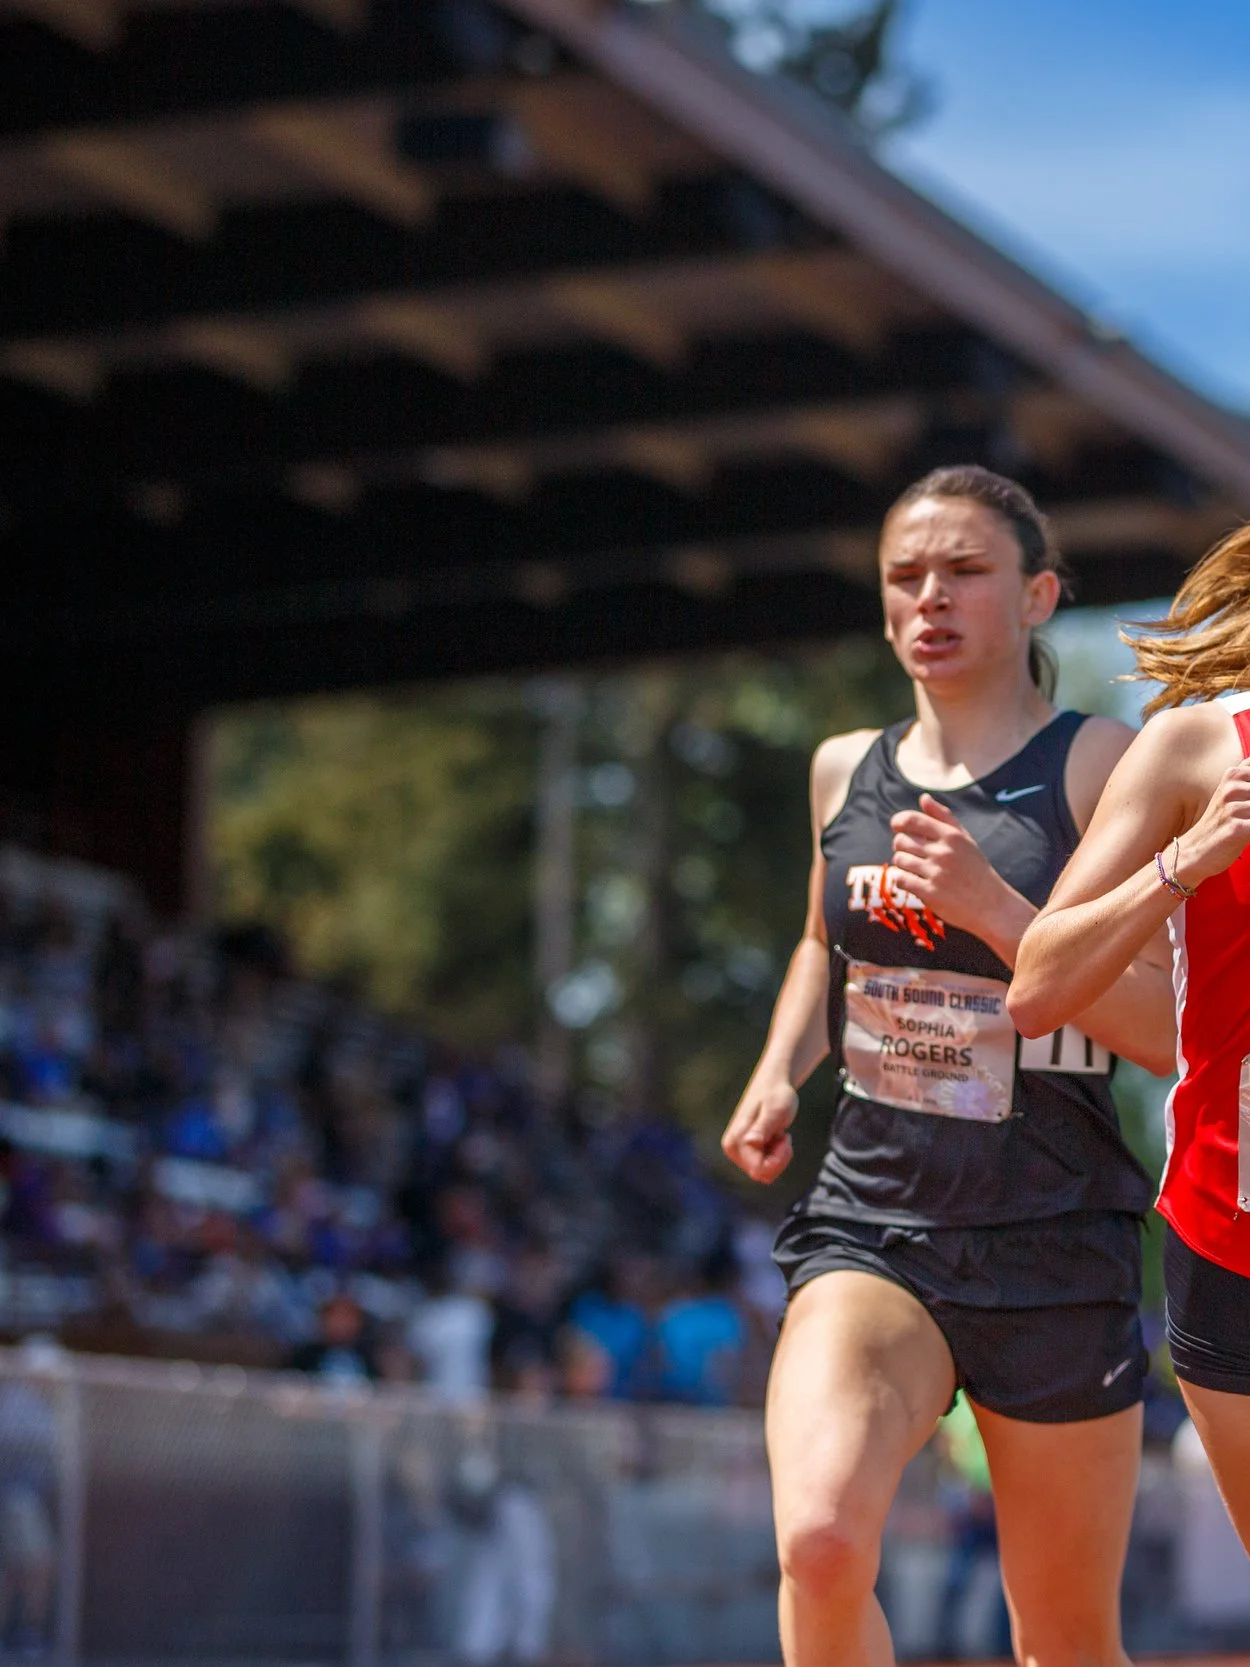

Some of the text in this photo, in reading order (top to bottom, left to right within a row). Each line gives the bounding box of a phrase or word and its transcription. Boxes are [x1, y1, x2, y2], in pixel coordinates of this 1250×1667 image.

[846, 865, 926, 911] TIG
[864, 979, 899, 1001] SOUTH
[903, 986, 945, 1007] SOUND
[949, 992, 1001, 1015] CLASSIC
[898, 1018, 956, 1038] SOPHIA
[880, 1034, 973, 1067] ROGERS
[883, 1062, 970, 1082] BATTLE GROUND
